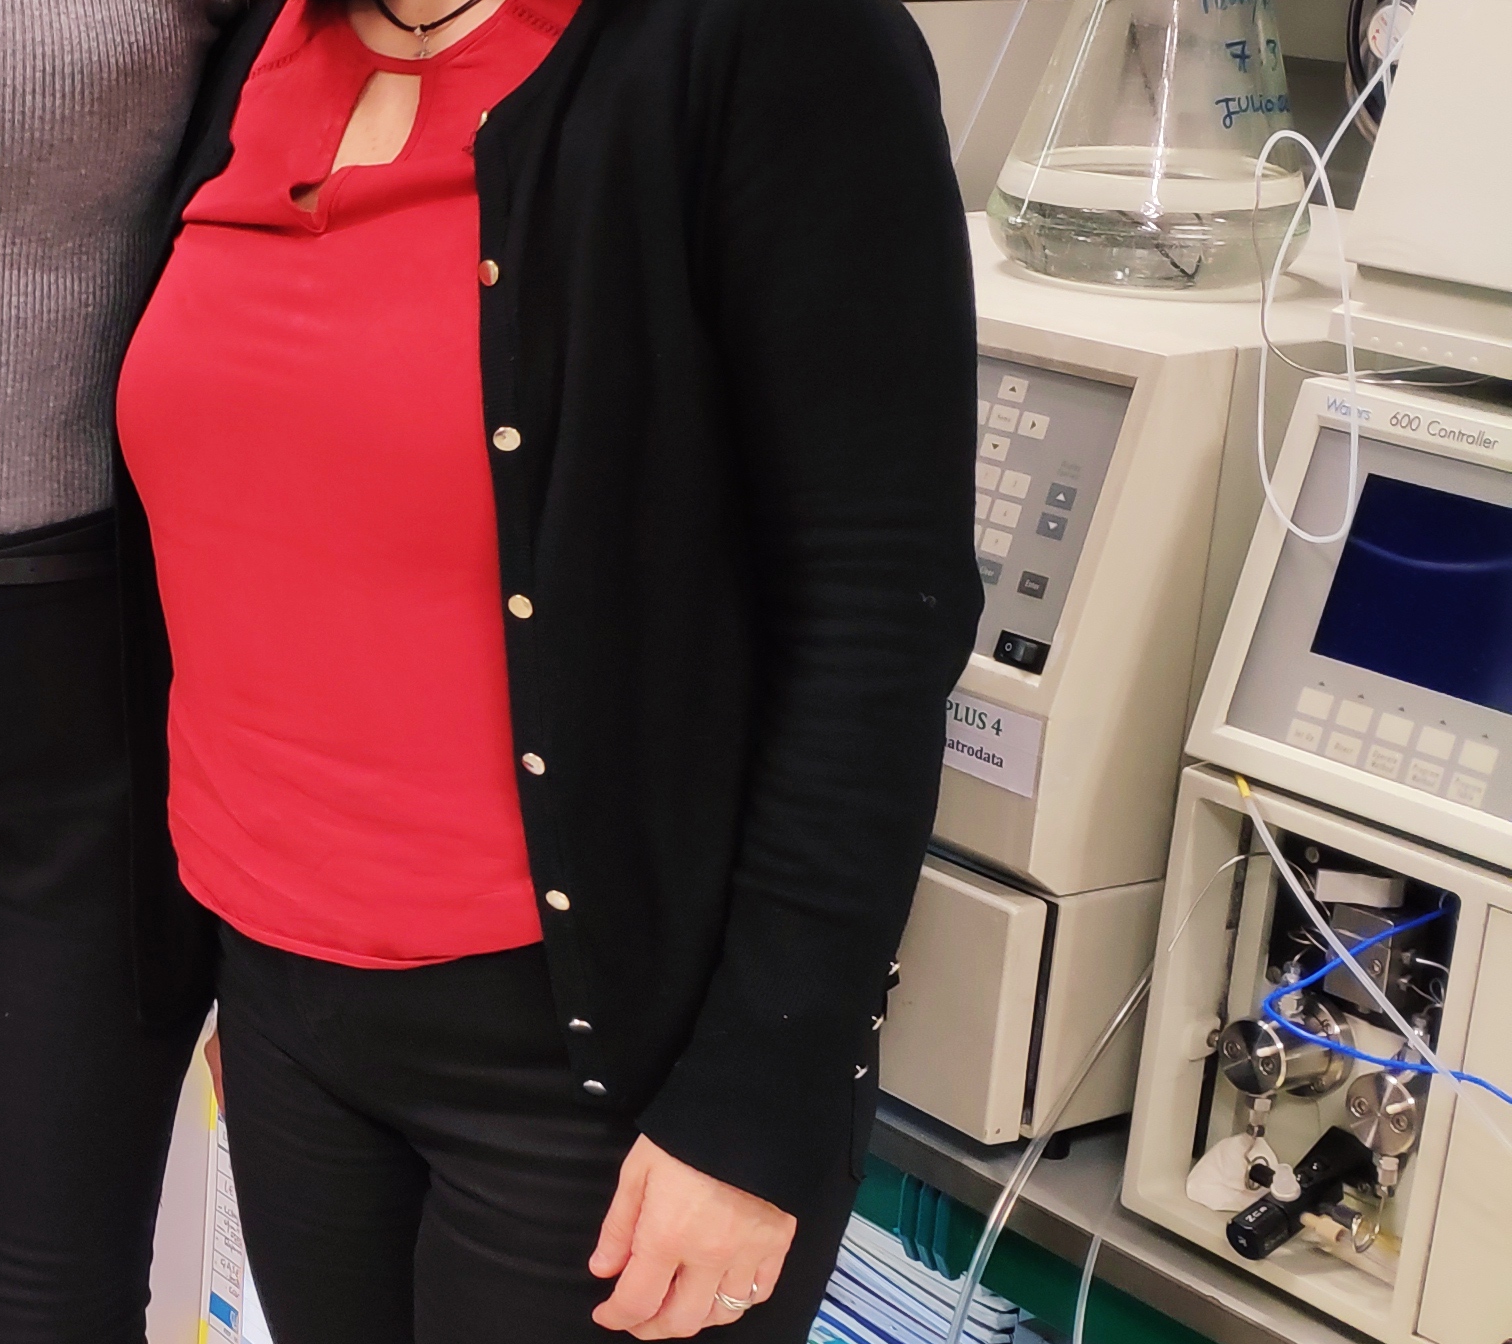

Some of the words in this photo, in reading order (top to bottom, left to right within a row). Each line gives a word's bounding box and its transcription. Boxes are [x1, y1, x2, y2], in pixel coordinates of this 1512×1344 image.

[1389, 411, 1422, 433] 600
[1427, 419, 1500, 451] Controller
[1023, 578, 1041, 592] Enter
[991, 718, 1004, 737] 4
[946, 738, 1004, 768] atrodata
